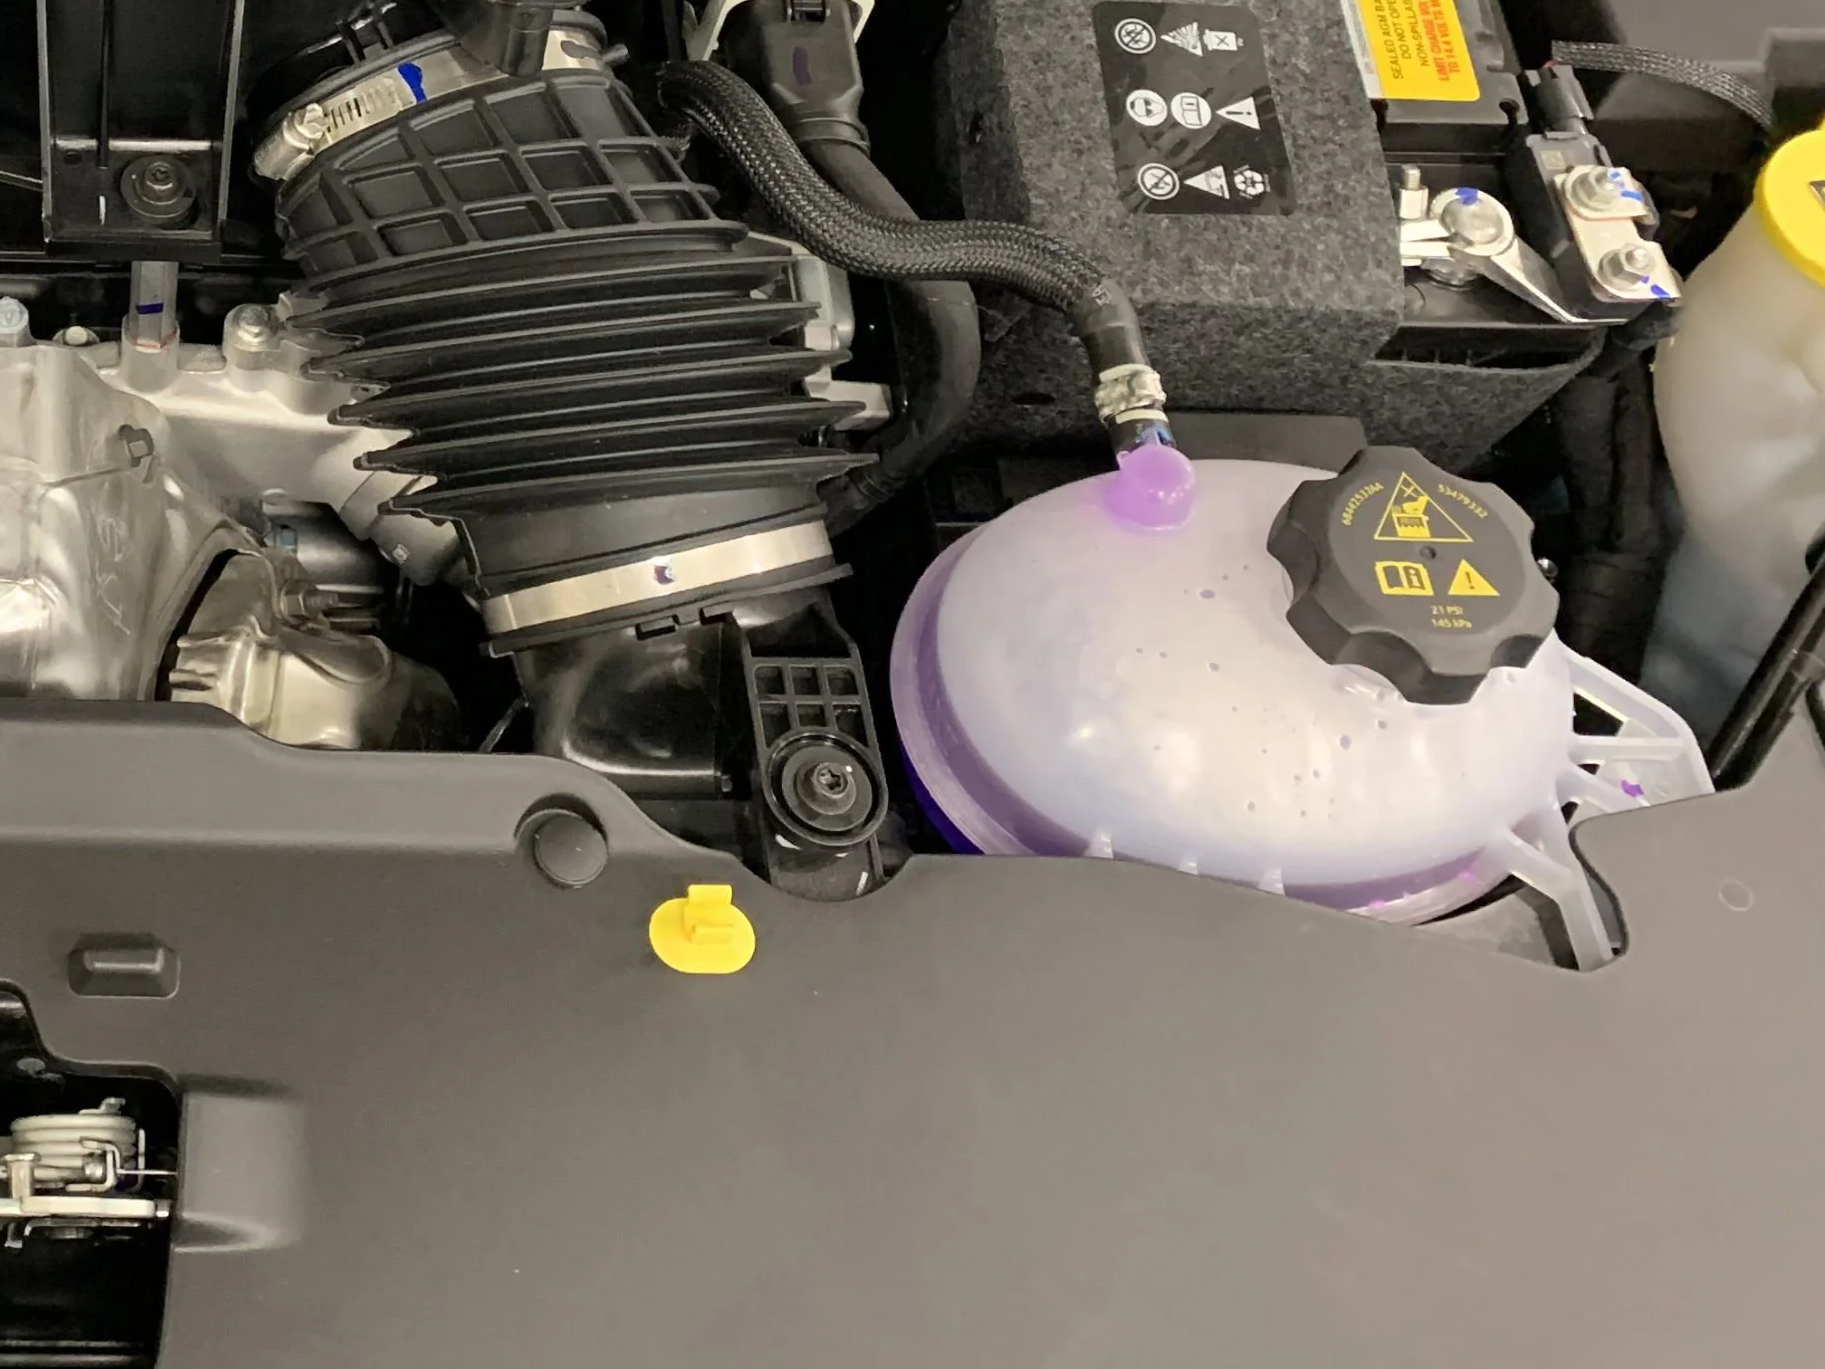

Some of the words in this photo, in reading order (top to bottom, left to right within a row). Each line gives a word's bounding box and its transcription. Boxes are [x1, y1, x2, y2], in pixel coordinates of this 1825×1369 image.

[1379, 14, 1392, 36] AGM
[1394, 21, 1407, 41] NOT
[1384, 39, 1404, 79] SEALED
[1400, 43, 1411, 59] DO
